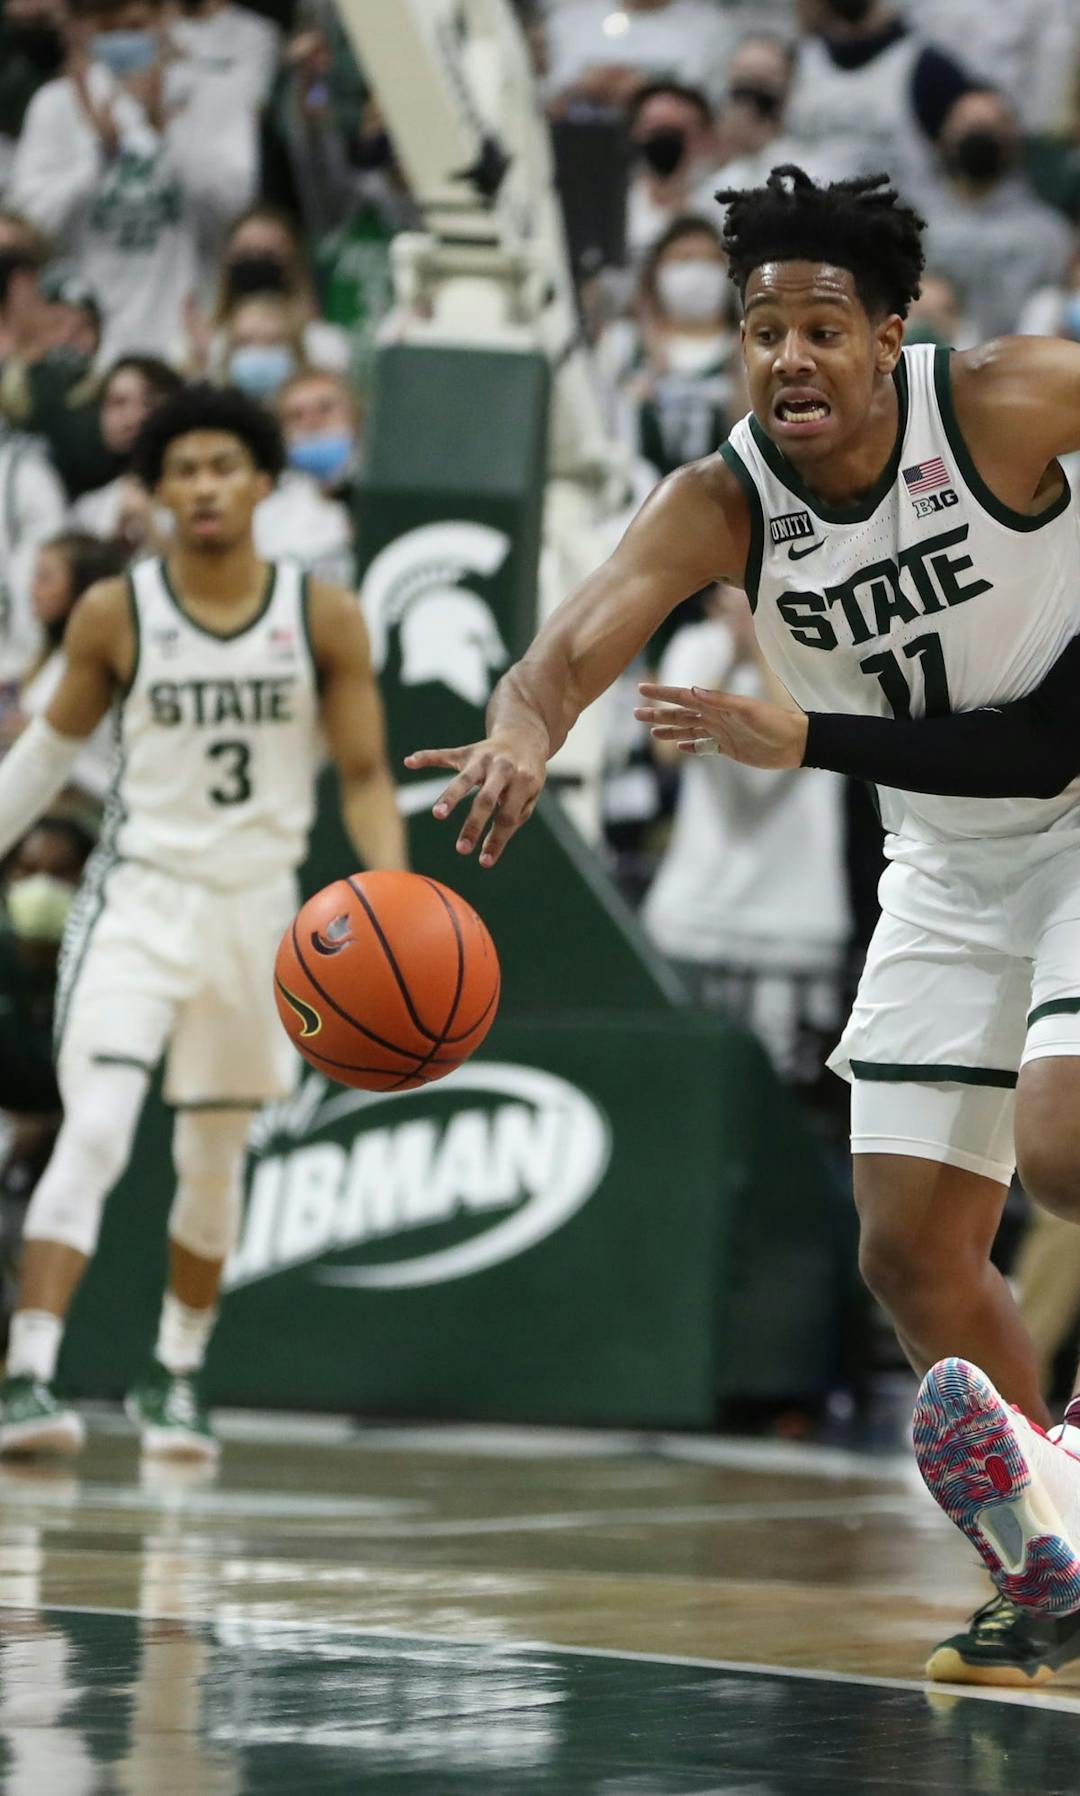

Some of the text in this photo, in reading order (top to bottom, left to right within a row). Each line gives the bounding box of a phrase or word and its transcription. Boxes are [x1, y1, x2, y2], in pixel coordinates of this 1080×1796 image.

[770, 513, 810, 540] UNITY
[776, 524, 994, 650] STATE
[149, 677, 296, 728] STATE
[860, 632, 951, 719] 11
[208, 738, 253, 808] 3
[222, 1104, 563, 1293] IBMAN
